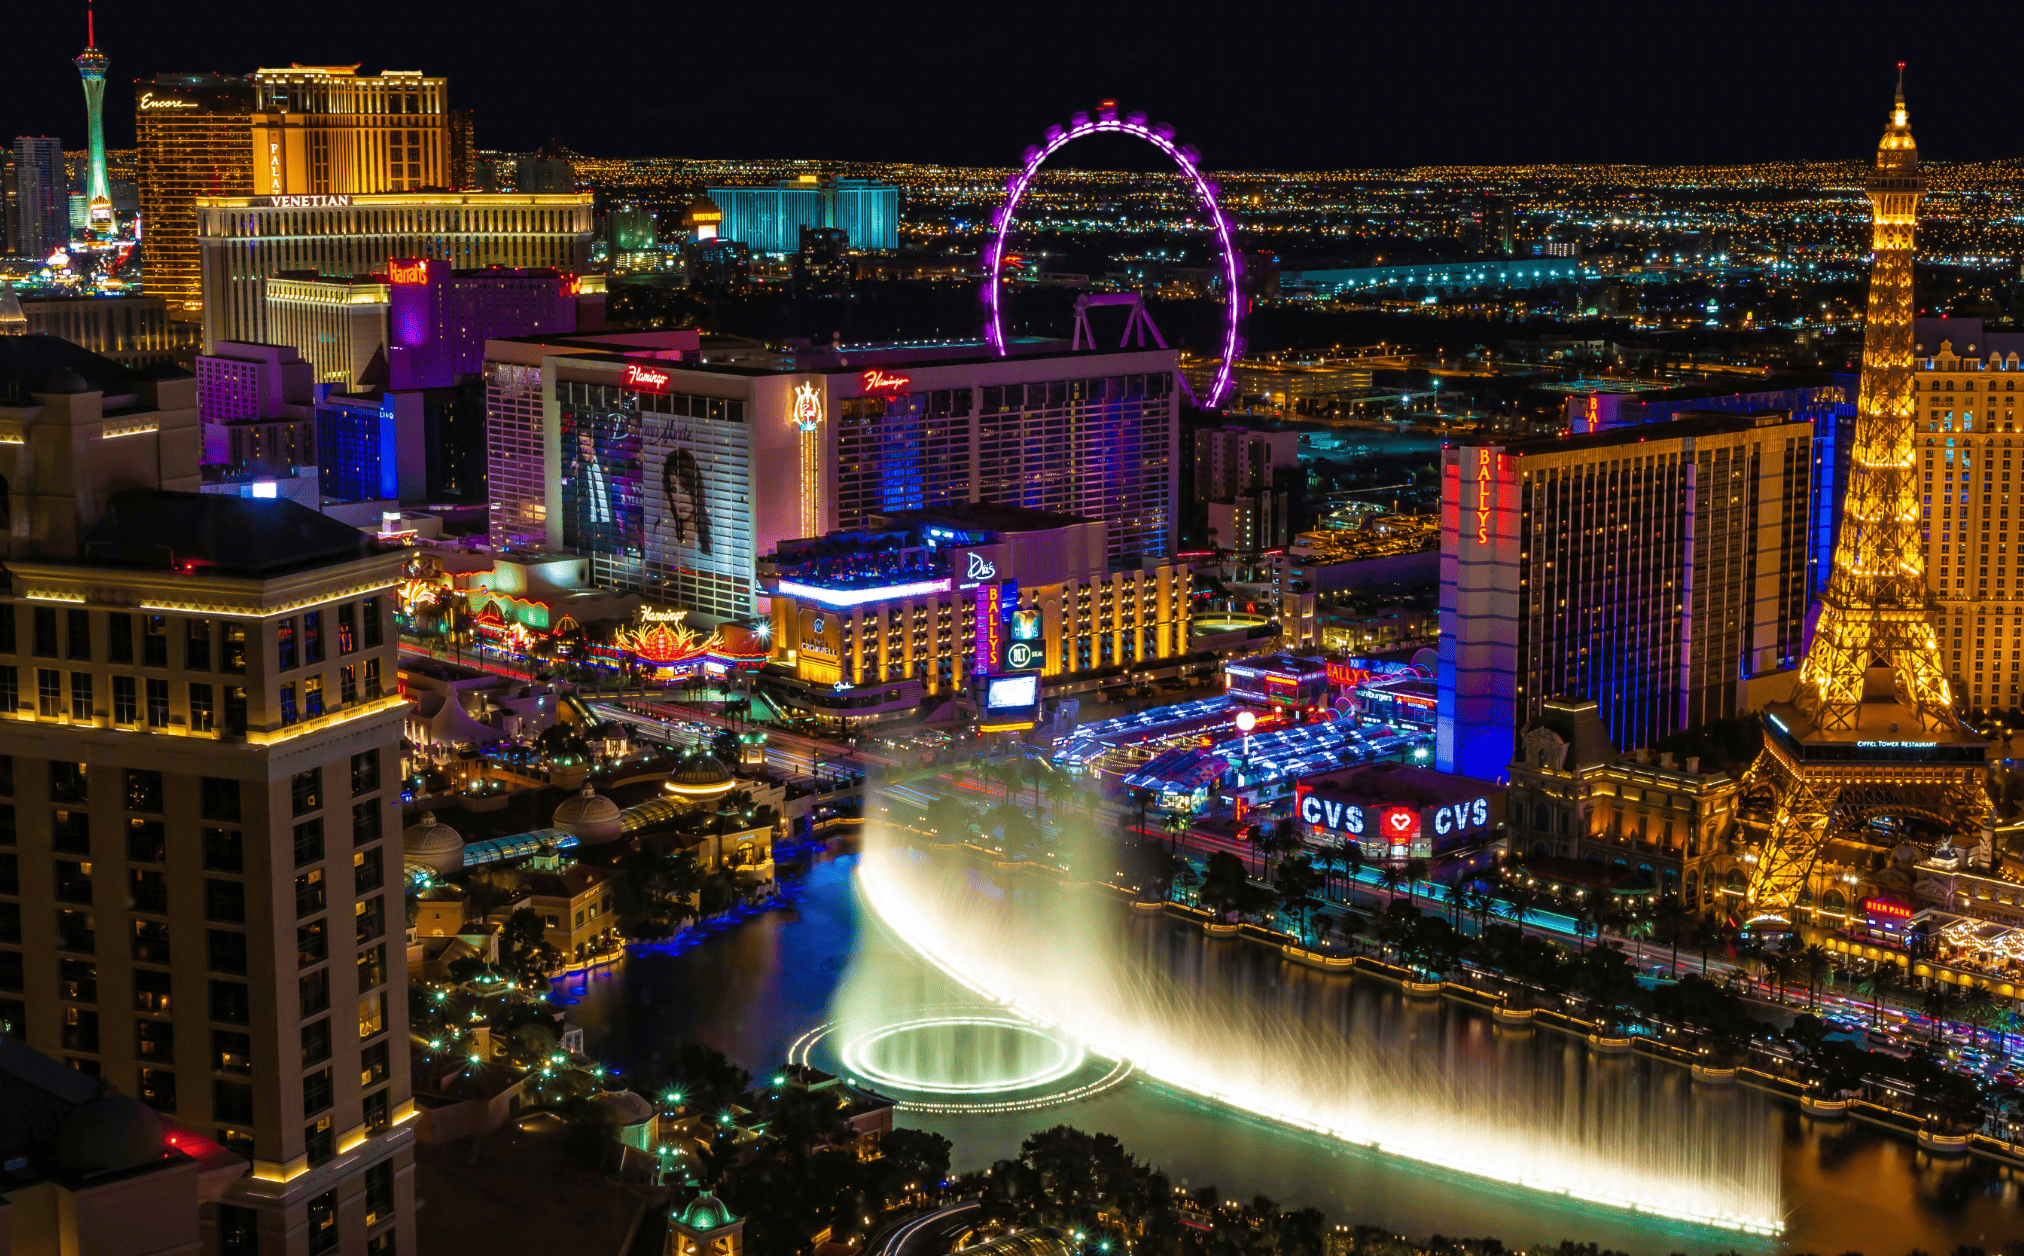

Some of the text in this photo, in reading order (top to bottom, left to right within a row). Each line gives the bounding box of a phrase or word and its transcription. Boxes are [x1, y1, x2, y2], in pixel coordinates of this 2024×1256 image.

[140, 92, 198, 109] Encore
[270, 195, 348, 207] VENETIAN
[692, 212, 721, 221] WESTGATE
[628, 365, 668, 389] Flamingo
[864, 371, 909, 390] Flamingo
[1477, 449, 1490, 544] BALLYS
[640, 605, 688, 626] Flamingo
[987, 588, 999, 664] BALLYS
[801, 642, 838, 657] CROMWELL
[1013, 648, 1027, 662] BLT
[1302, 796, 1364, 834] CVS
[1434, 798, 1487, 835] CVS
[1866, 901, 1910, 917] BEER PARK
